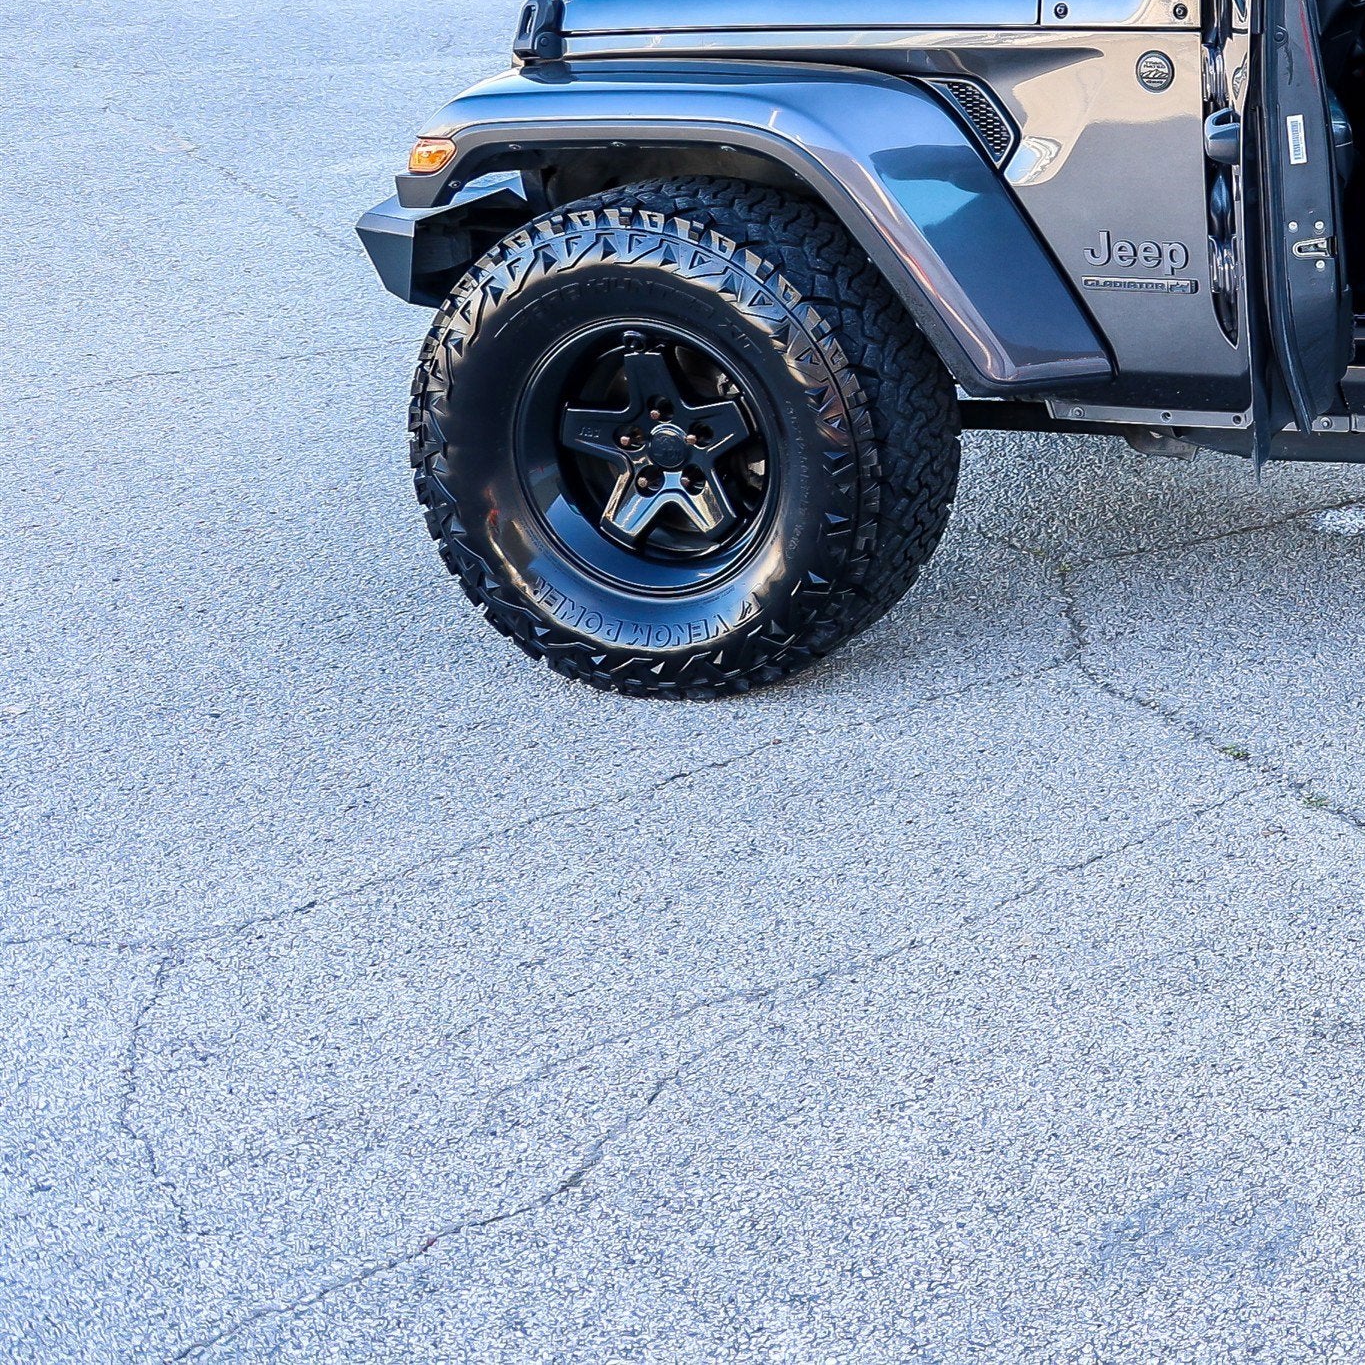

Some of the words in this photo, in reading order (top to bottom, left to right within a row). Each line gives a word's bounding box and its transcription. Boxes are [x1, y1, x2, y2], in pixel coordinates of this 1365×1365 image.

[1083, 230, 1189, 276] Jeep
[1083, 278, 1166, 291] GLADIATOR
[531, 575, 623, 643] POWER
[627, 613, 729, 648] VENOM
